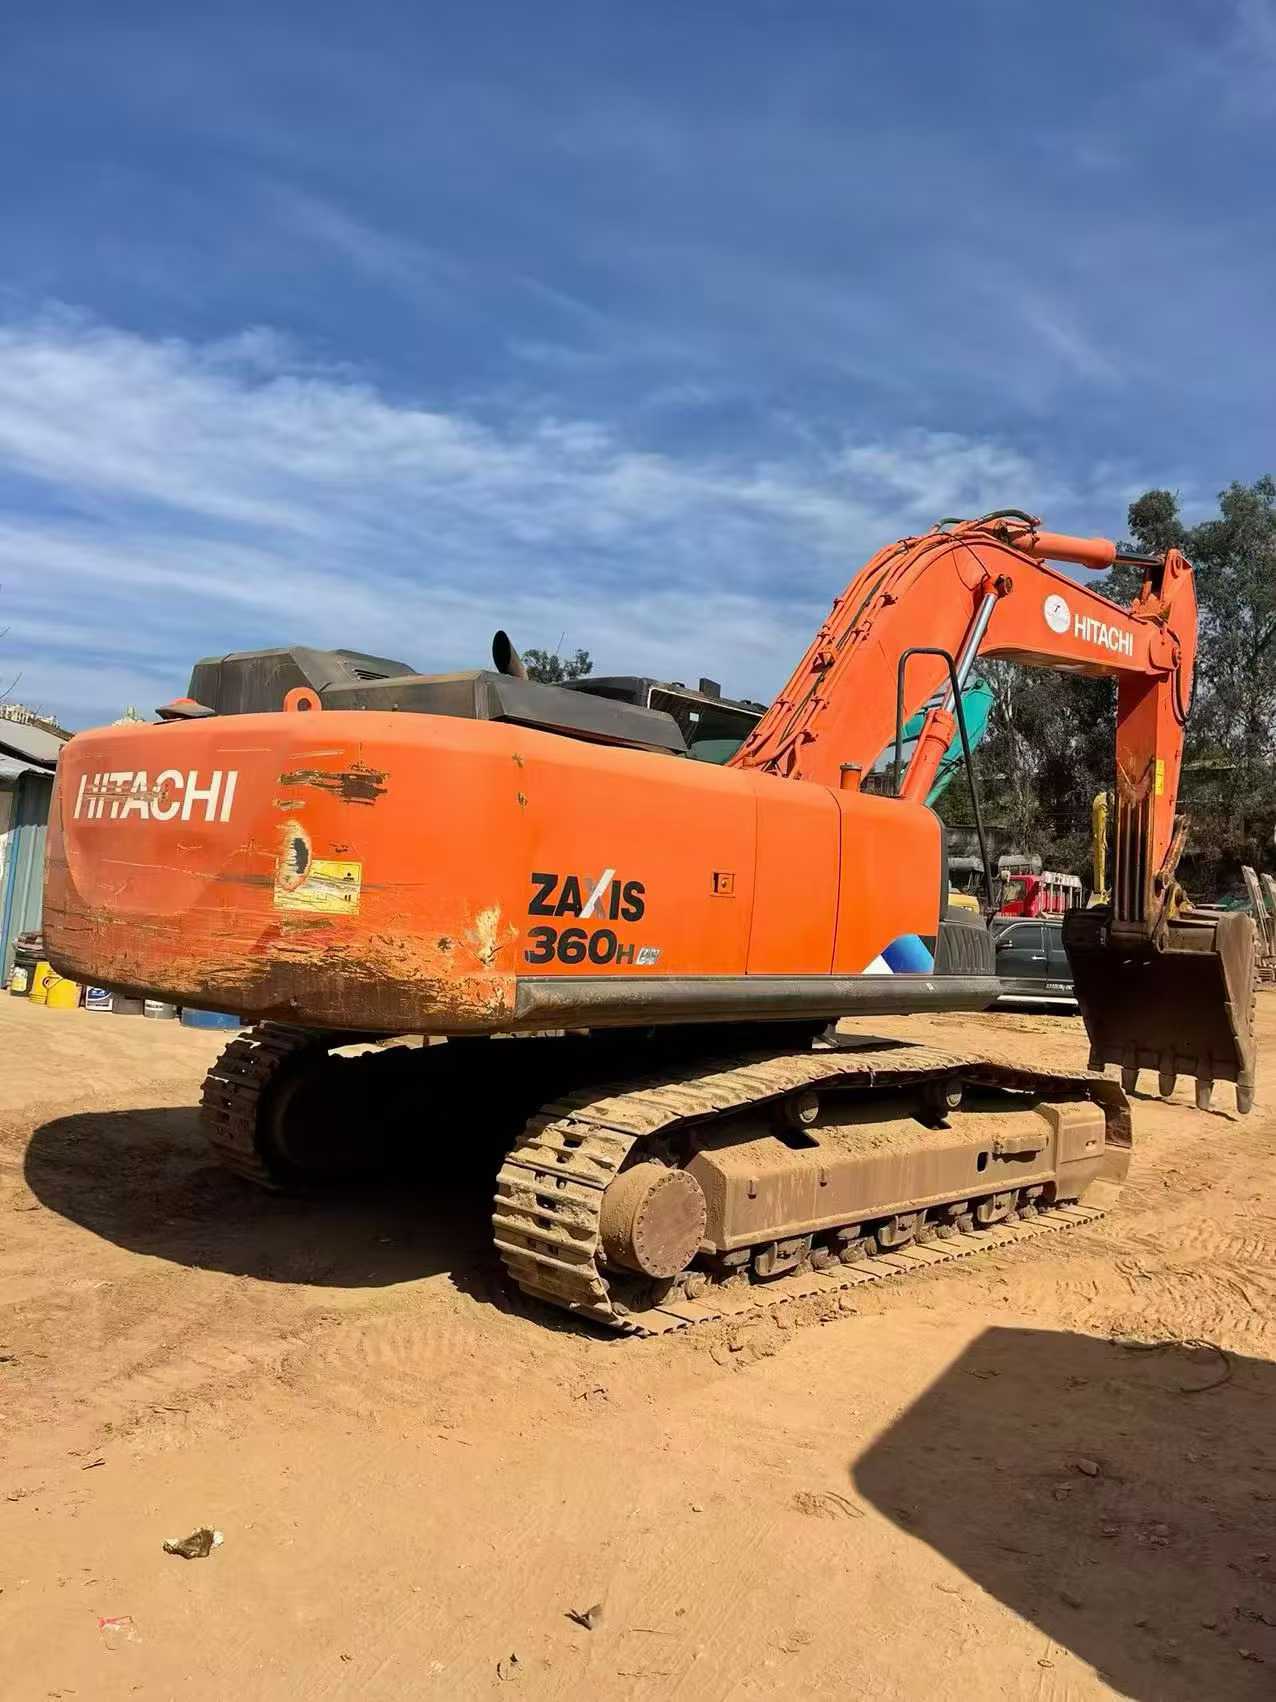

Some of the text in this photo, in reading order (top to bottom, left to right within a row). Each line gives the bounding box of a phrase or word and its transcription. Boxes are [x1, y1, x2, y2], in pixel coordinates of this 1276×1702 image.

[1073, 614, 1134, 657] HITACHI
[73, 769, 239, 823] HITACHI
[528, 868, 646, 922] ZAXIS
